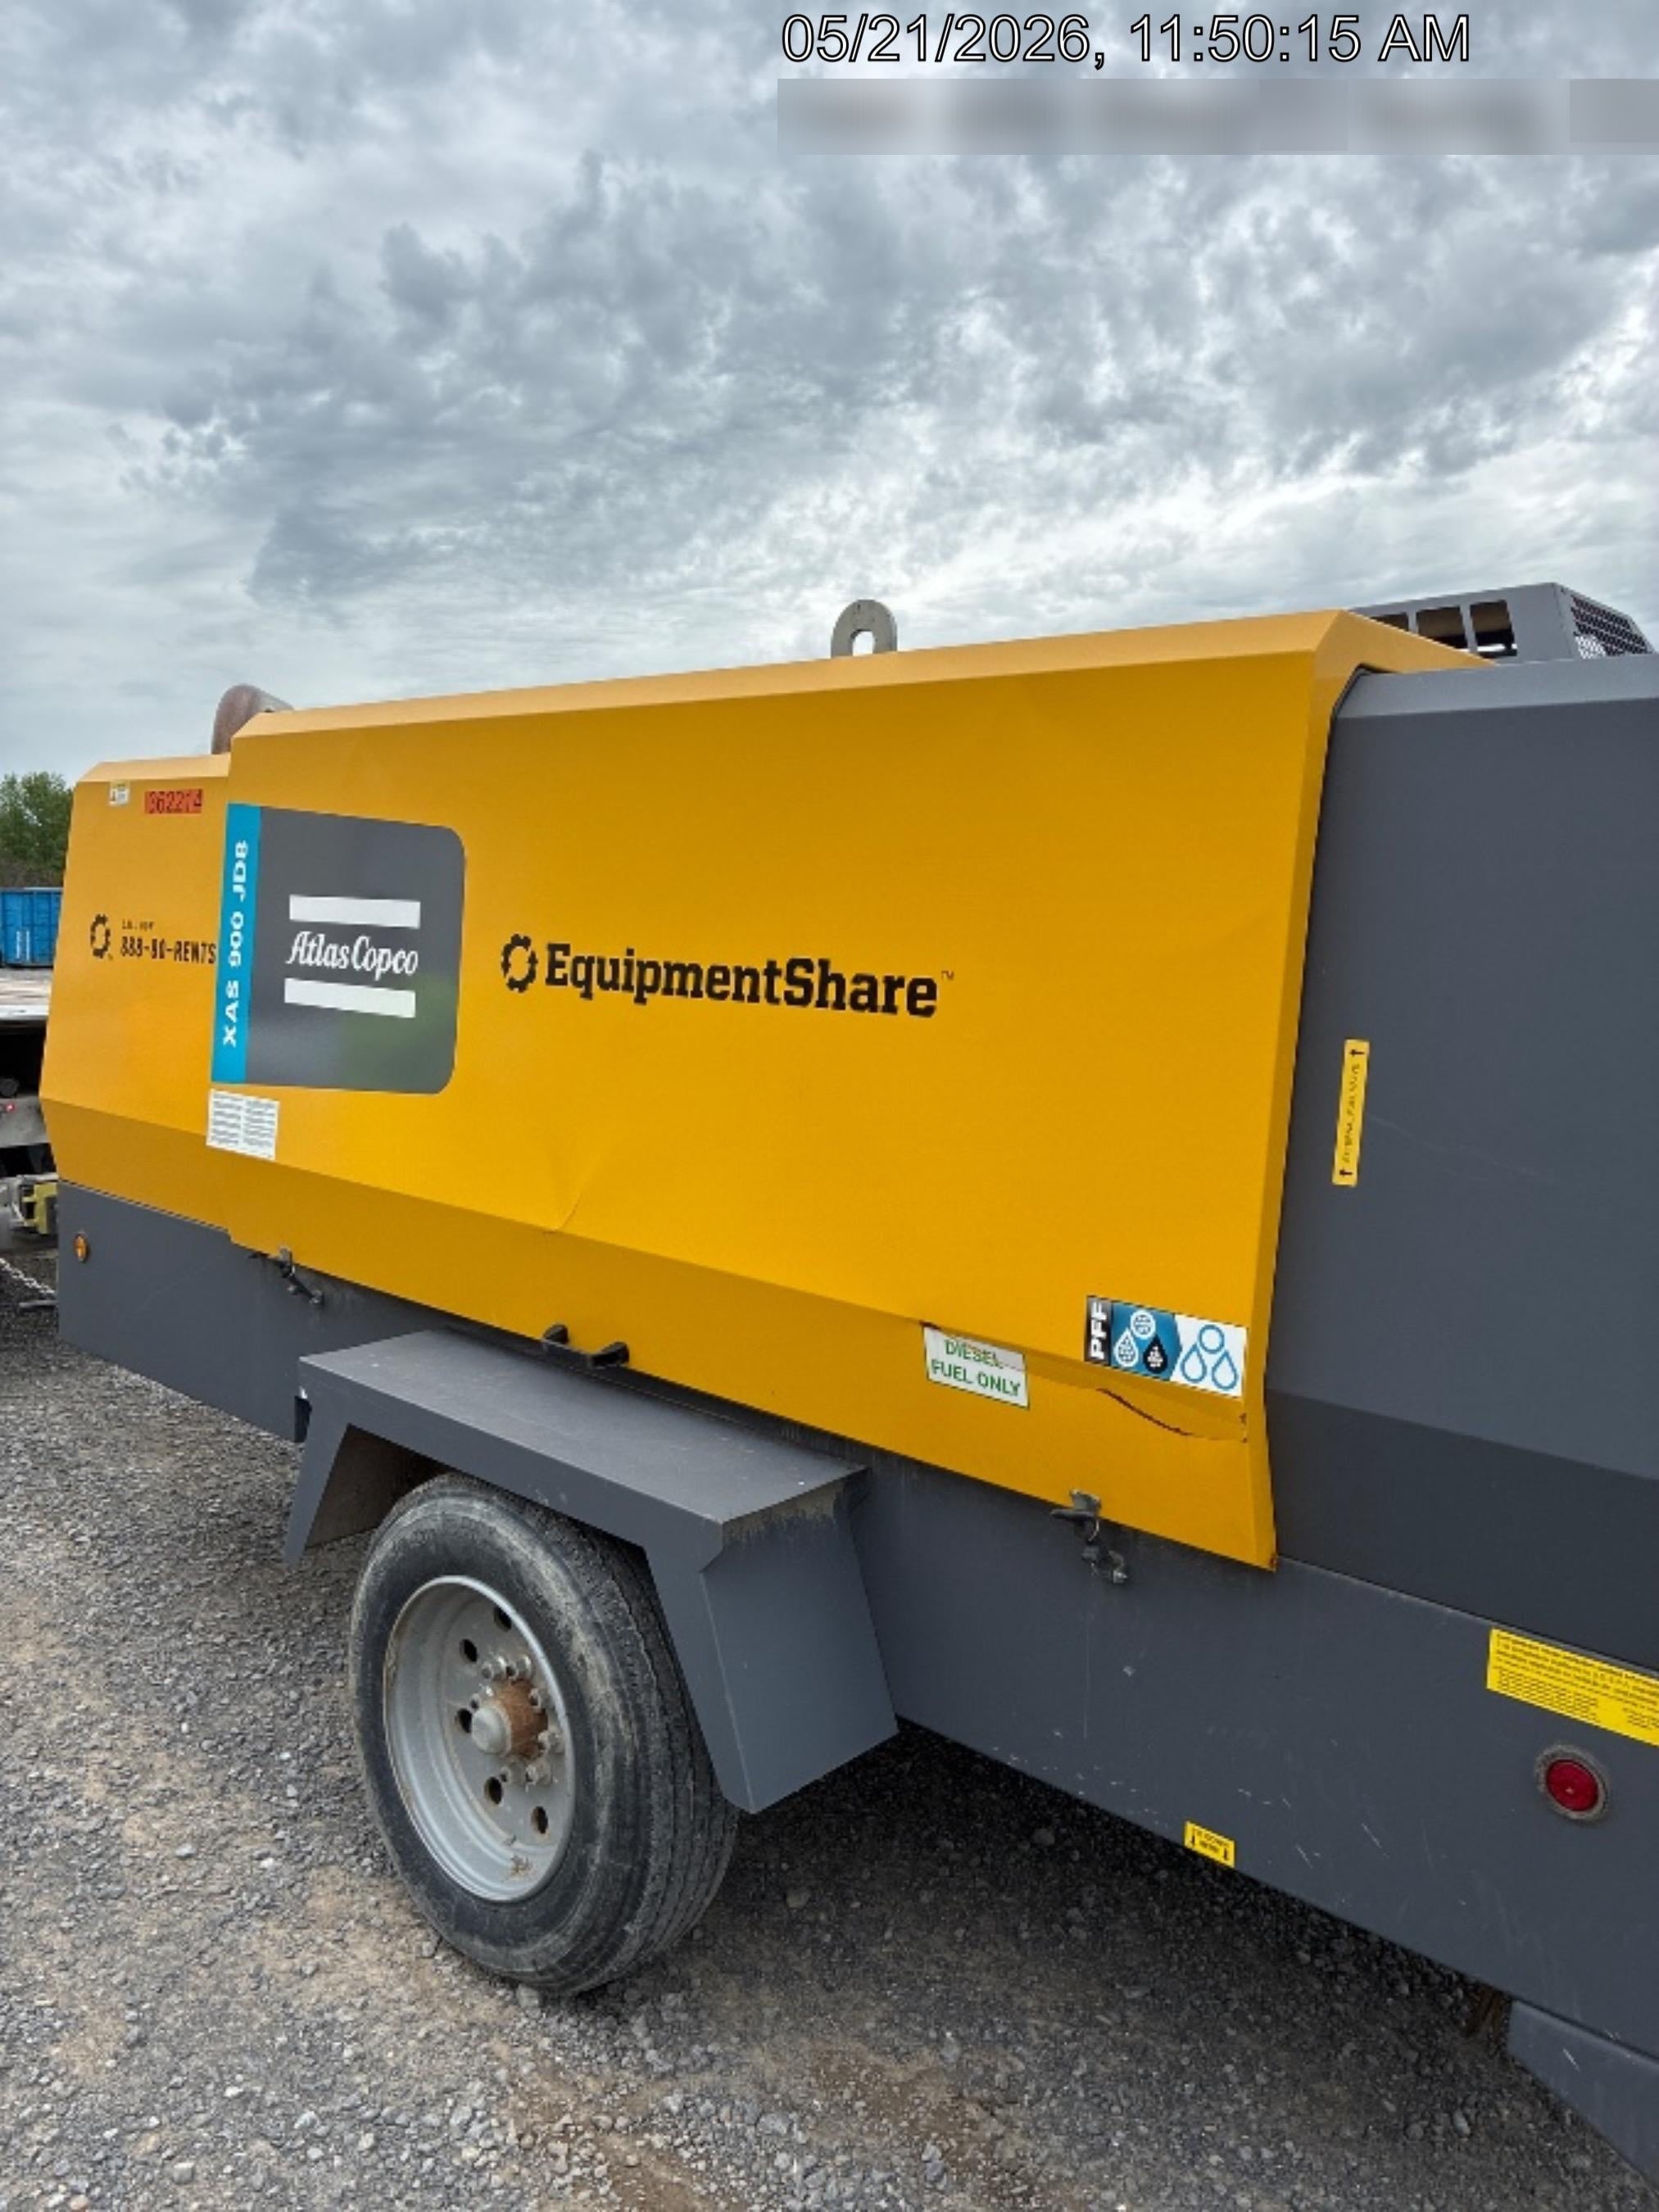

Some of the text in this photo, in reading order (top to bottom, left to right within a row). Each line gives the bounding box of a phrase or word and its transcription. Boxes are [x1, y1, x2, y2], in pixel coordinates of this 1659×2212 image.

[229, 911, 244, 968] 900
[546, 942, 938, 1018] EquipmentShare
[223, 980, 239, 1048] XAS
[944, 1338, 1004, 1369] DIESEL
[1090, 1299, 1107, 1360] PFF
[931, 1358, 1021, 1396] FUEL ONLY
